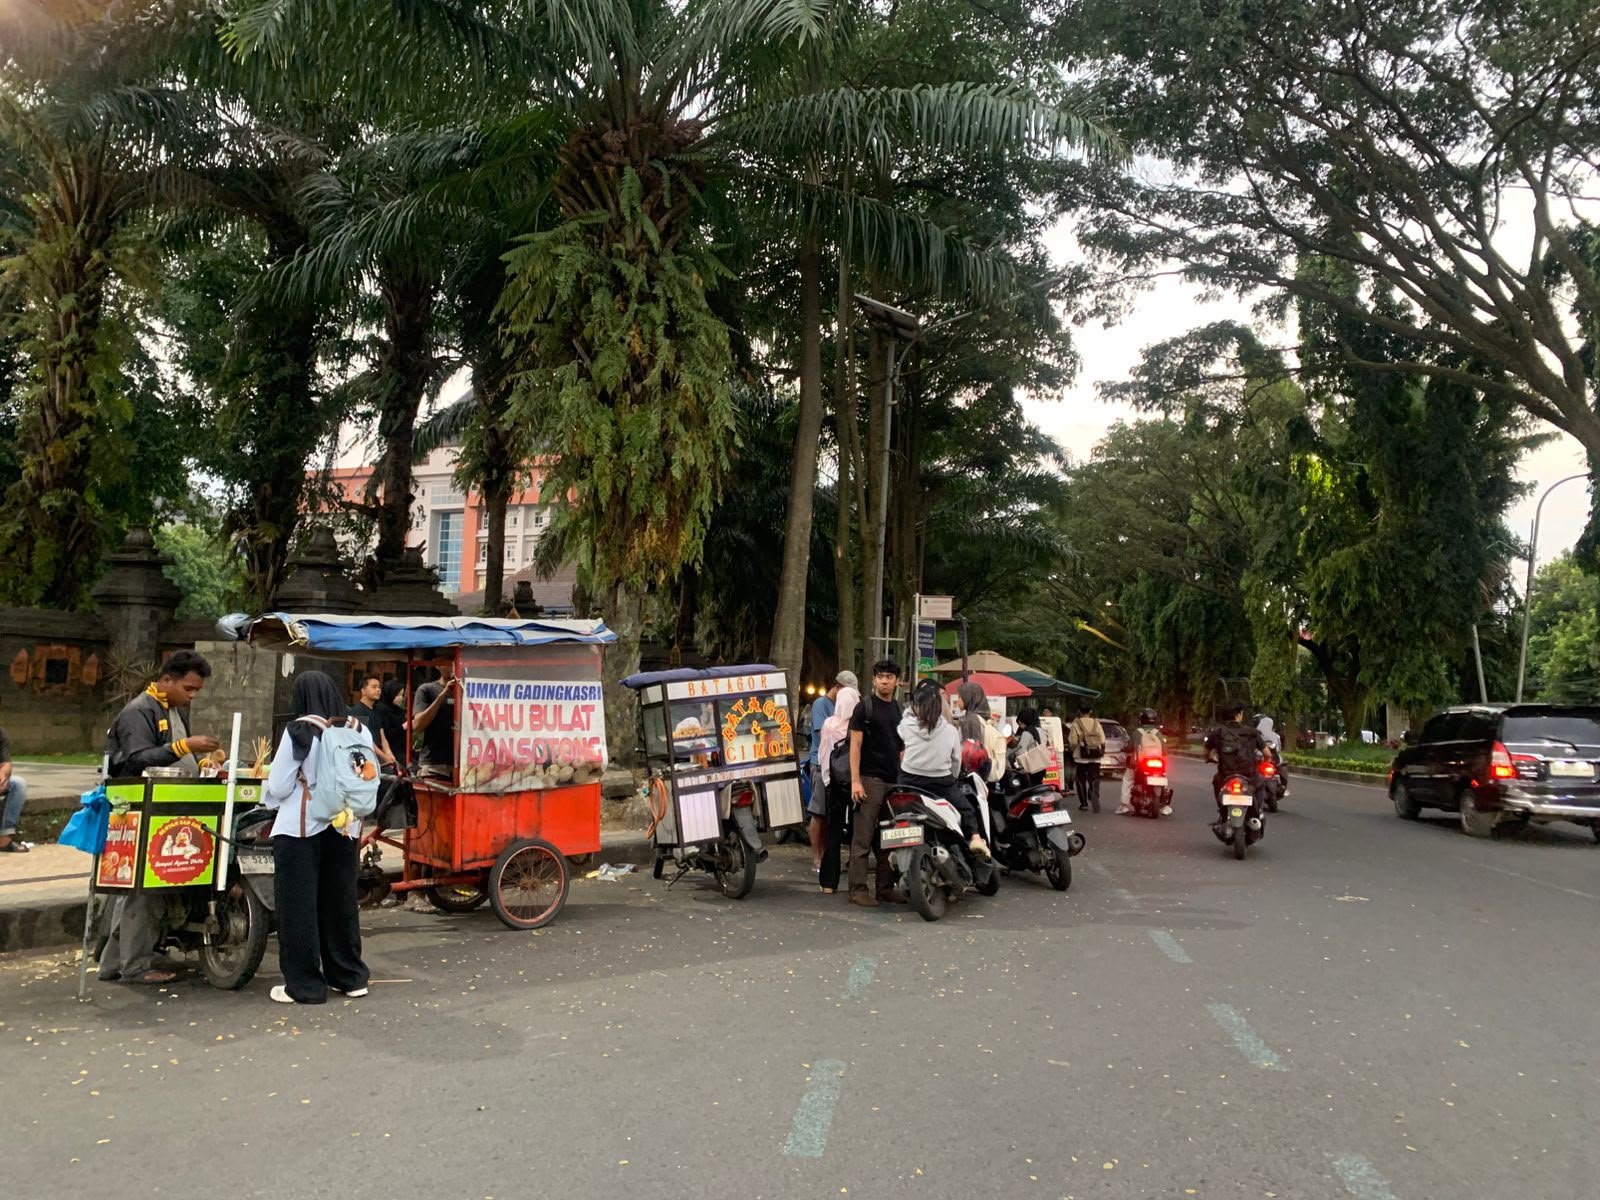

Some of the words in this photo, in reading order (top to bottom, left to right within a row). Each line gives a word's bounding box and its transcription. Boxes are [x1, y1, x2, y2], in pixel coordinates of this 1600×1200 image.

[466, 682, 512, 699] UMKM
[513, 684, 601, 701] GADINGKASRI
[687, 675, 768, 697] BATAGOR
[468, 702, 524, 732] TAHU
[529, 704, 595, 732] BULAT
[721, 697, 792, 743] BATAGOR
[467, 737, 514, 767] DAN
[516, 736, 603, 766] SOTONG
[726, 739, 793, 762] CIMOL
